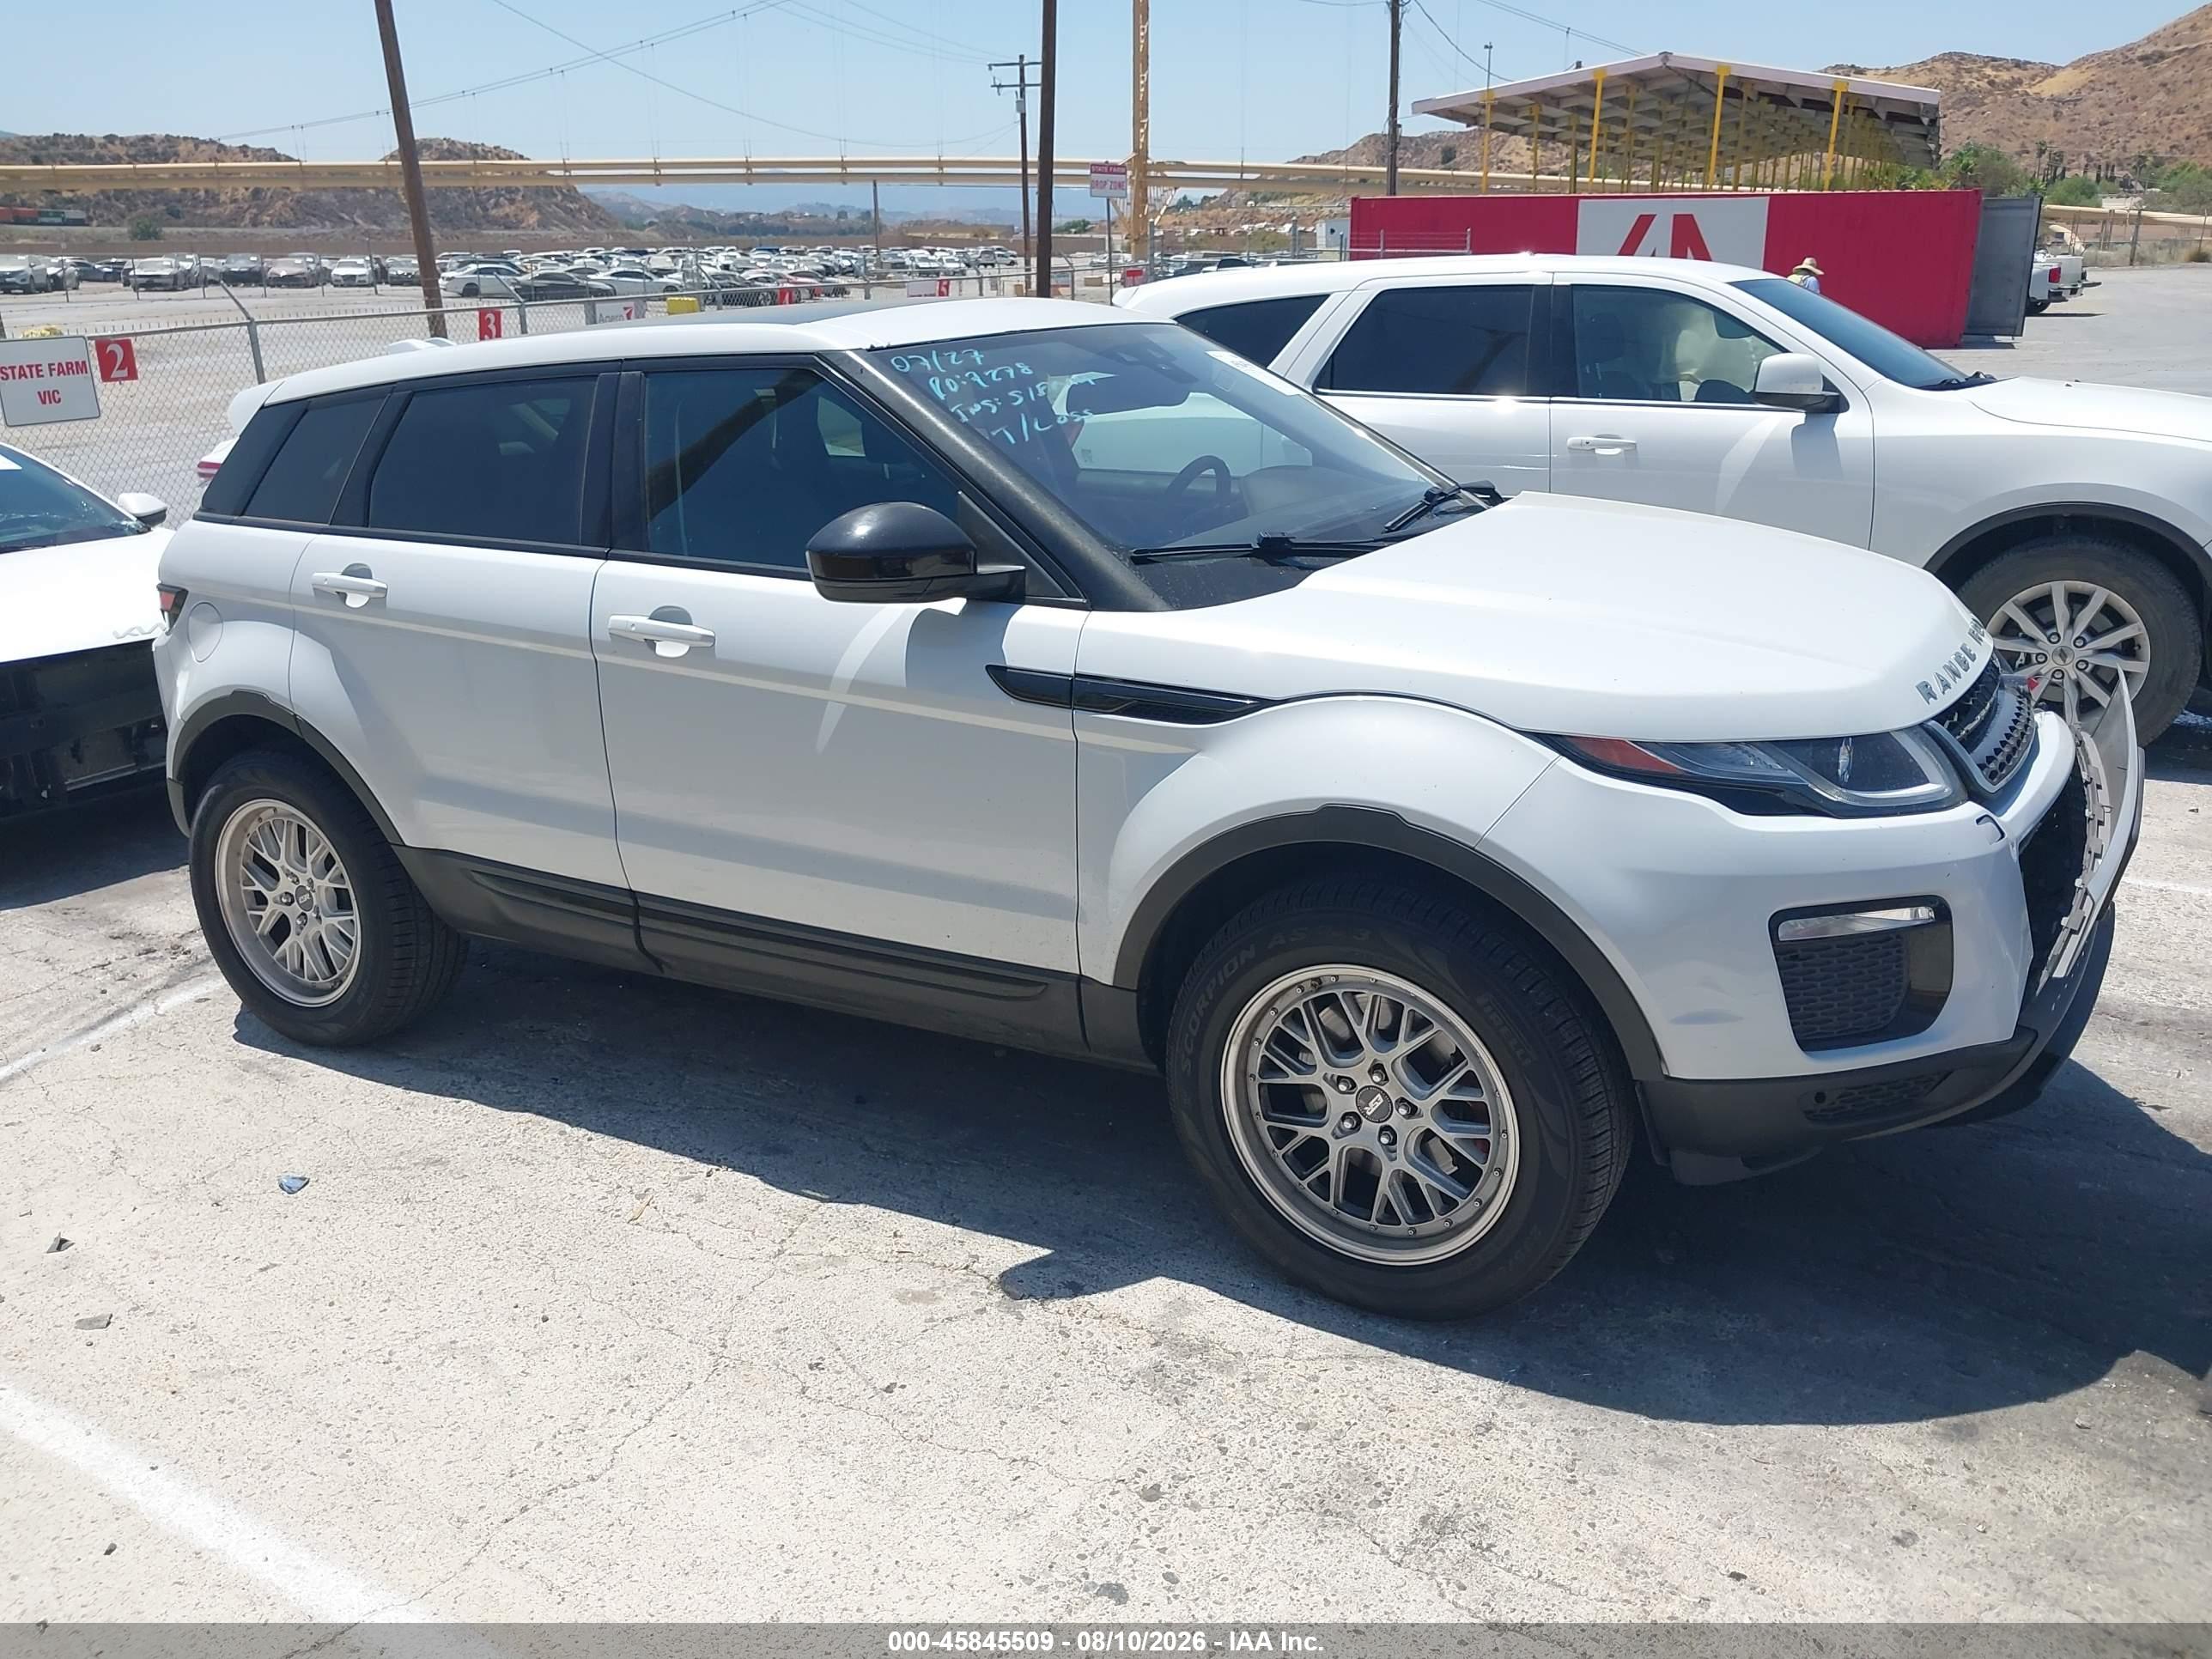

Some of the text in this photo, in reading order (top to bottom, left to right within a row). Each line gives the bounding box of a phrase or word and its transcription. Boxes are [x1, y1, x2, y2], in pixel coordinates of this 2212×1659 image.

[1091, 179, 1126, 191] DROP ZONE
[484, 313, 495, 339] 3
[0, 362, 88, 381] STATE FARM
[106, 343, 129, 379] 2
[37, 389, 62, 405] VIC
[1915, 643, 1977, 705] RANGE
[1180, 943, 1257, 1073] SCORPION
